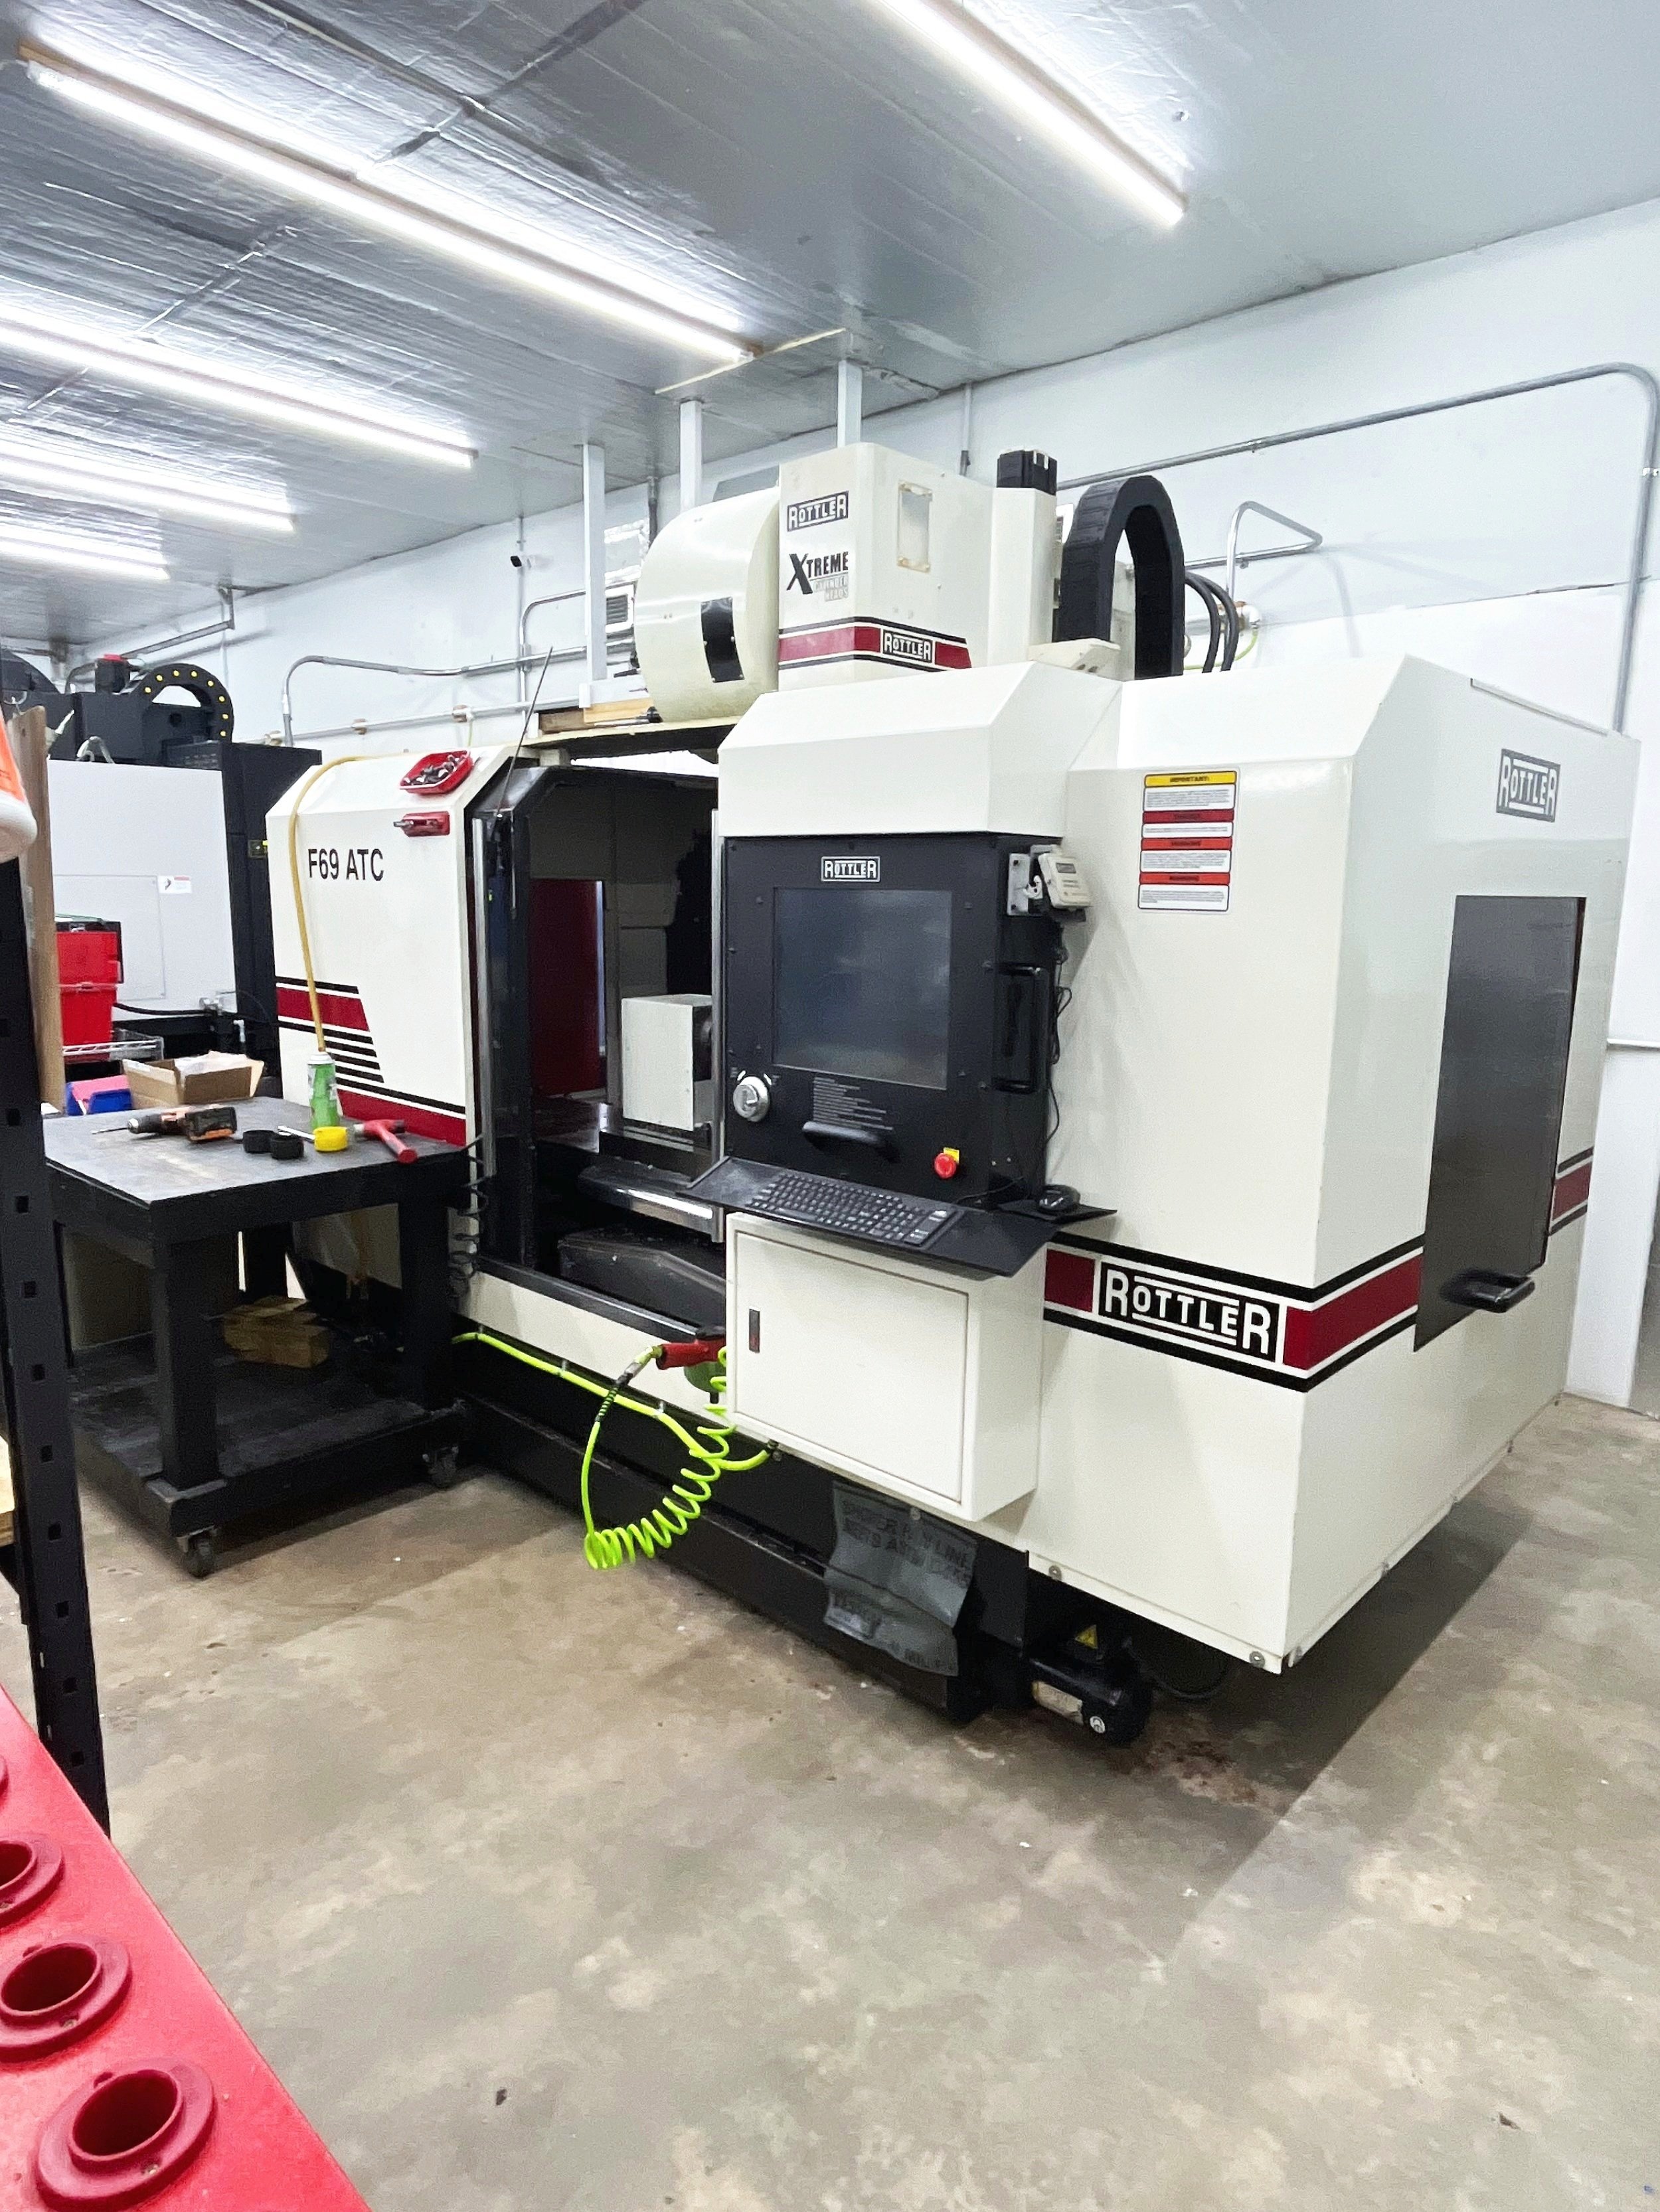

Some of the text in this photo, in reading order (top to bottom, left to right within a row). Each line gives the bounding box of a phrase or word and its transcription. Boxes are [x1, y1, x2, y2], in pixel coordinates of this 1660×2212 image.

[788, 494, 847, 530] ROTTLER
[786, 551, 849, 595] XTREME
[884, 632, 932, 661] ROTTLER
[1498, 755, 1558, 816] ROTTLER
[307, 848, 384, 882] F69 ATC
[824, 860, 877, 878] ROTTLER
[1104, 1269, 1272, 1355] ROTTLER
